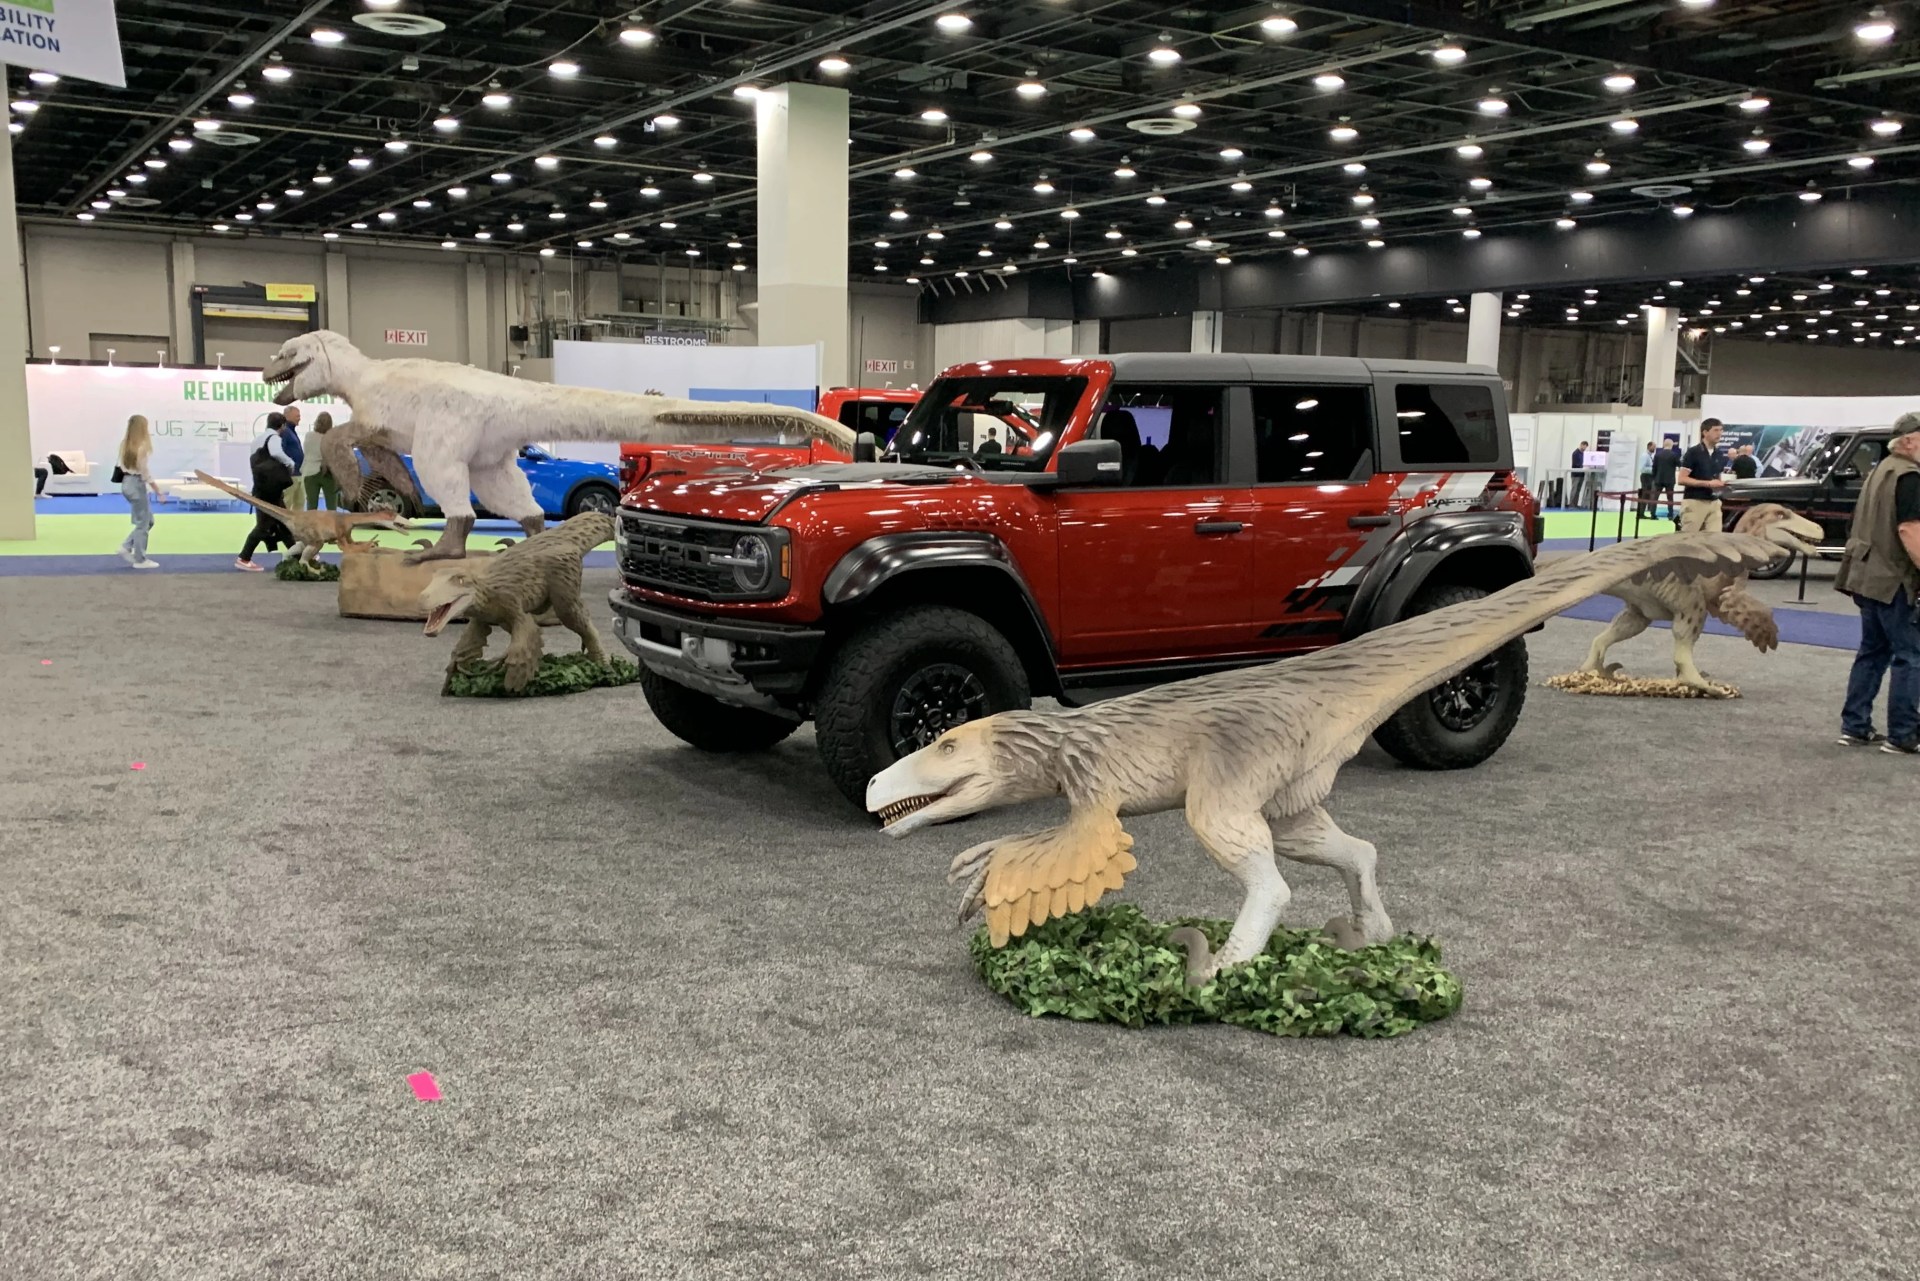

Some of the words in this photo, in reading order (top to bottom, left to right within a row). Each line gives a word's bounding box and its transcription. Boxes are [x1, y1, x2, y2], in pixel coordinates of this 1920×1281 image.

[398, 331, 427, 344] EXIT
[644, 335, 707, 347] RESTROOMS
[875, 360, 897, 372] EXIT
[183, 380, 280, 402] RECHARG
[666, 449, 748, 463] RAPTOR
